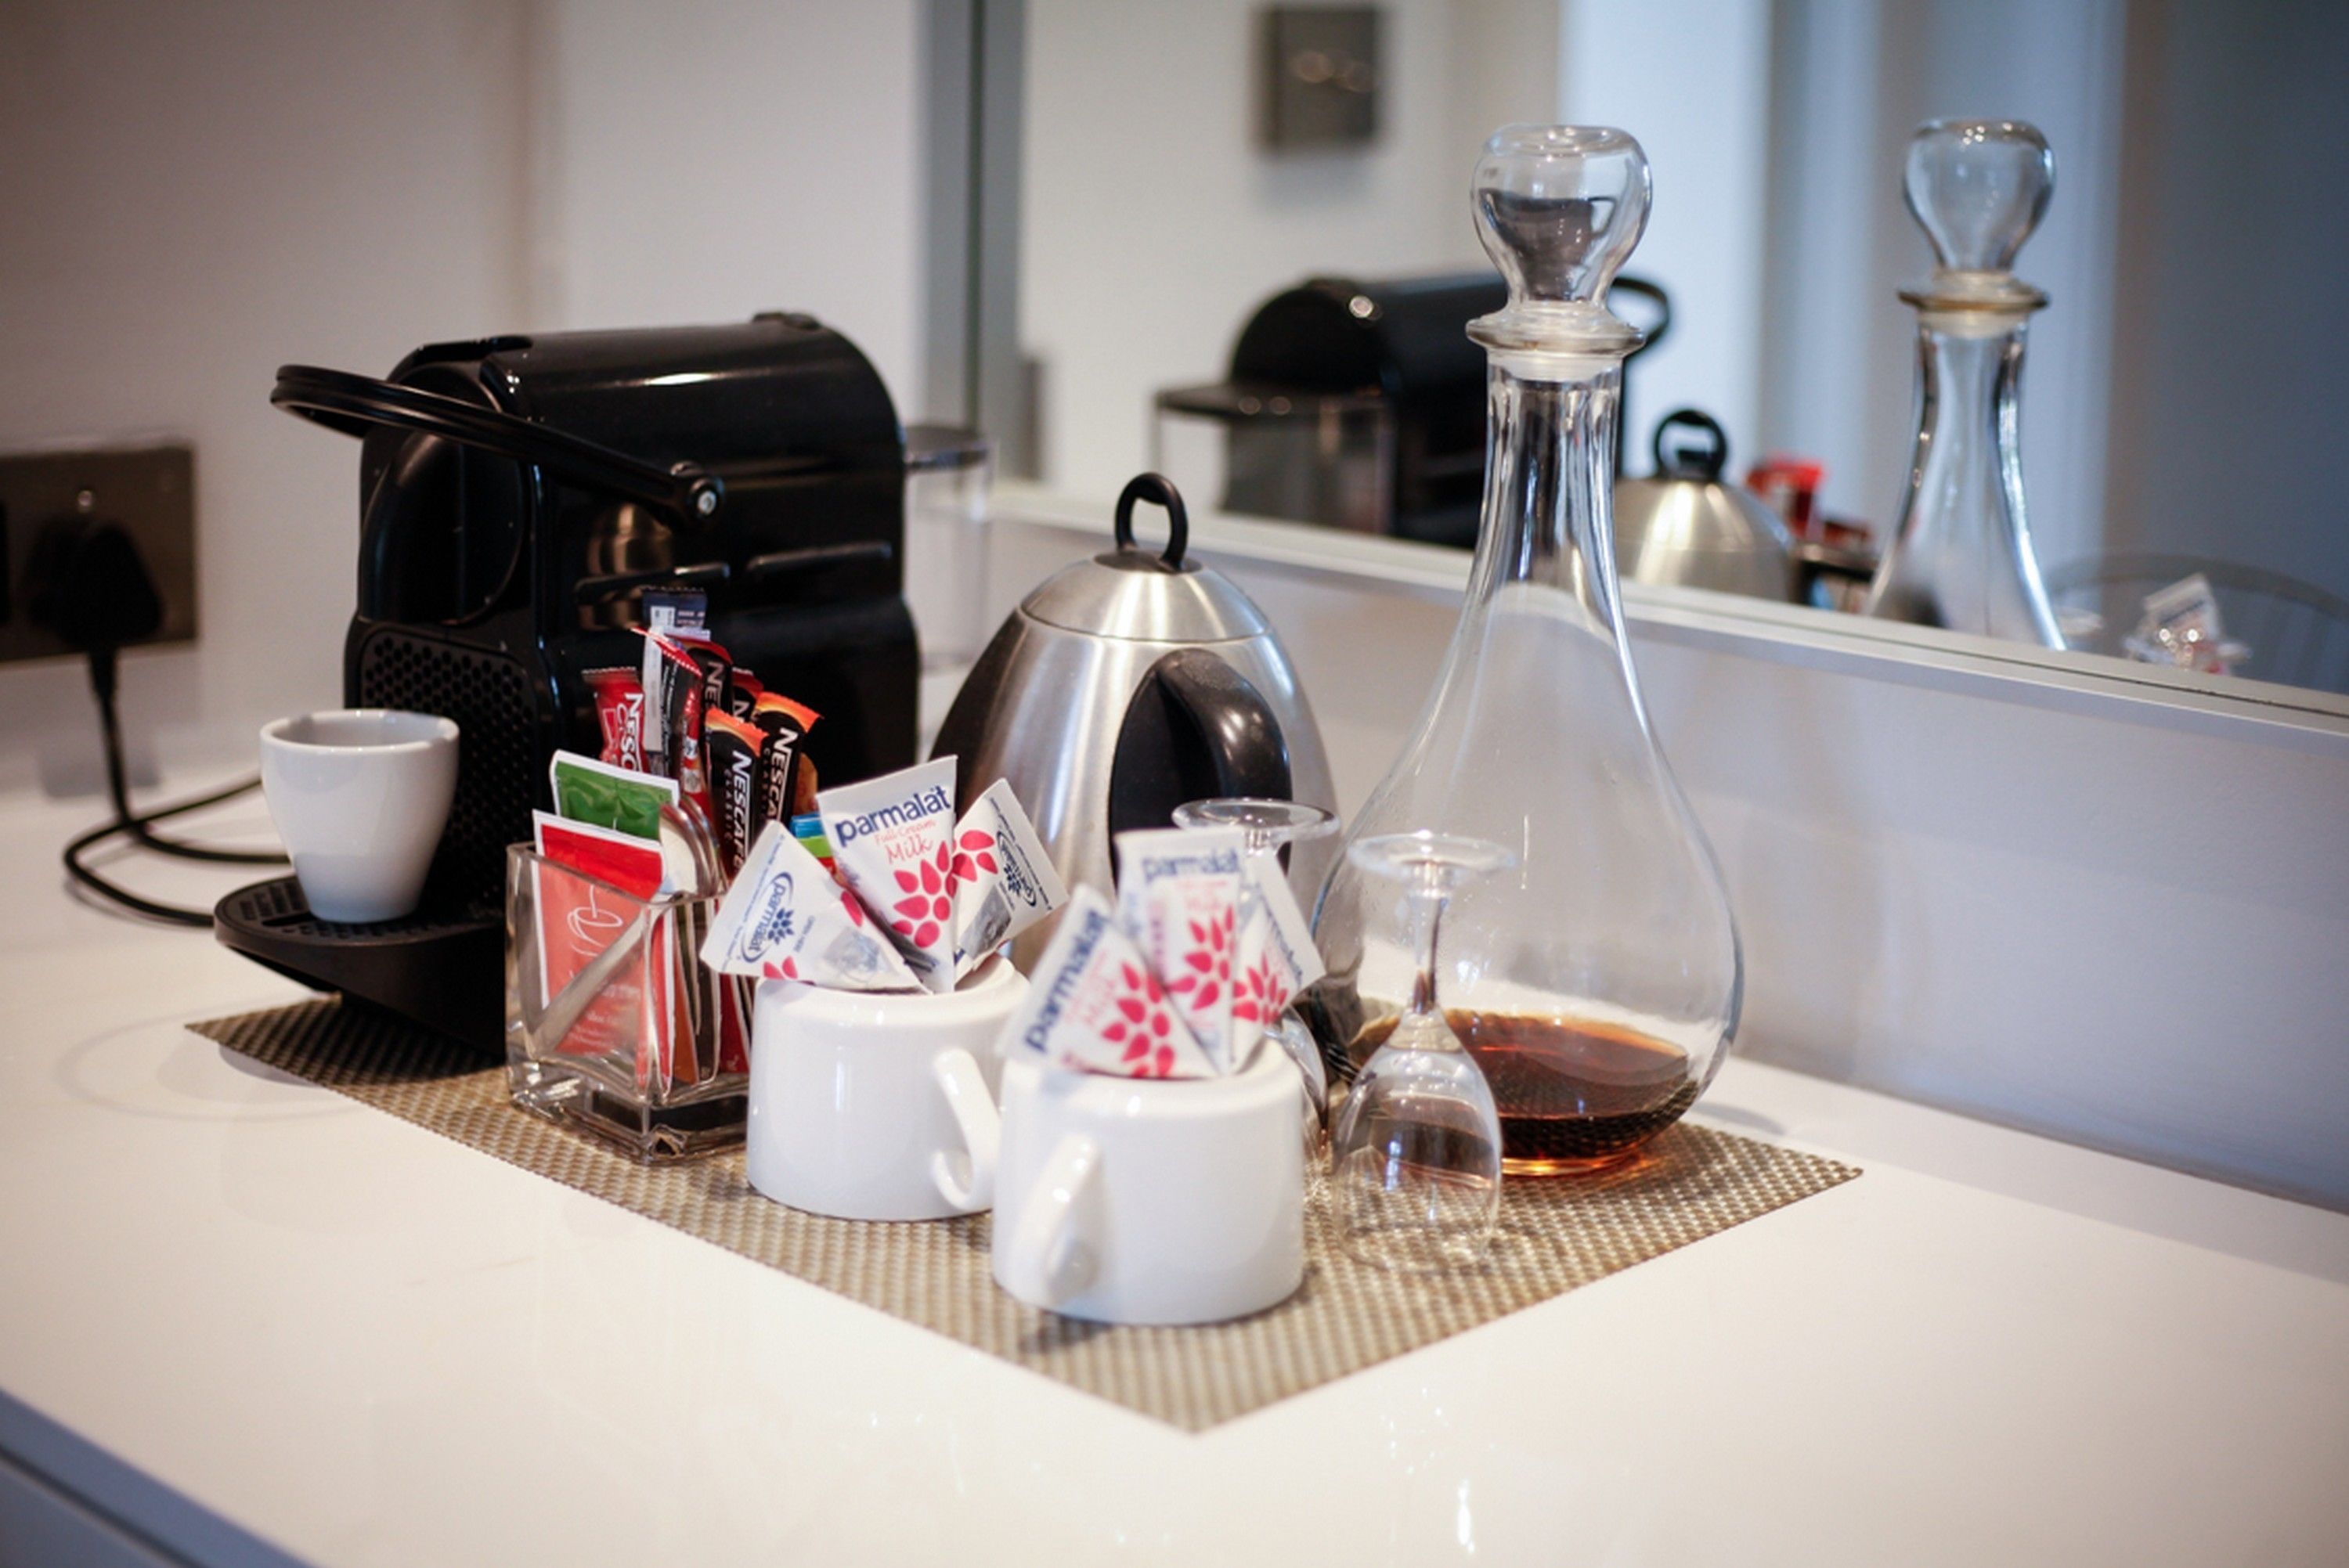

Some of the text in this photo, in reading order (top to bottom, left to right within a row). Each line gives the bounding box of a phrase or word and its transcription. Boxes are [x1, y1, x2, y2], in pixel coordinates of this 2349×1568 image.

[835, 785, 951, 848] parmalat
[886, 833, 933, 864] Milk
[748, 881, 786, 953] parmalat
